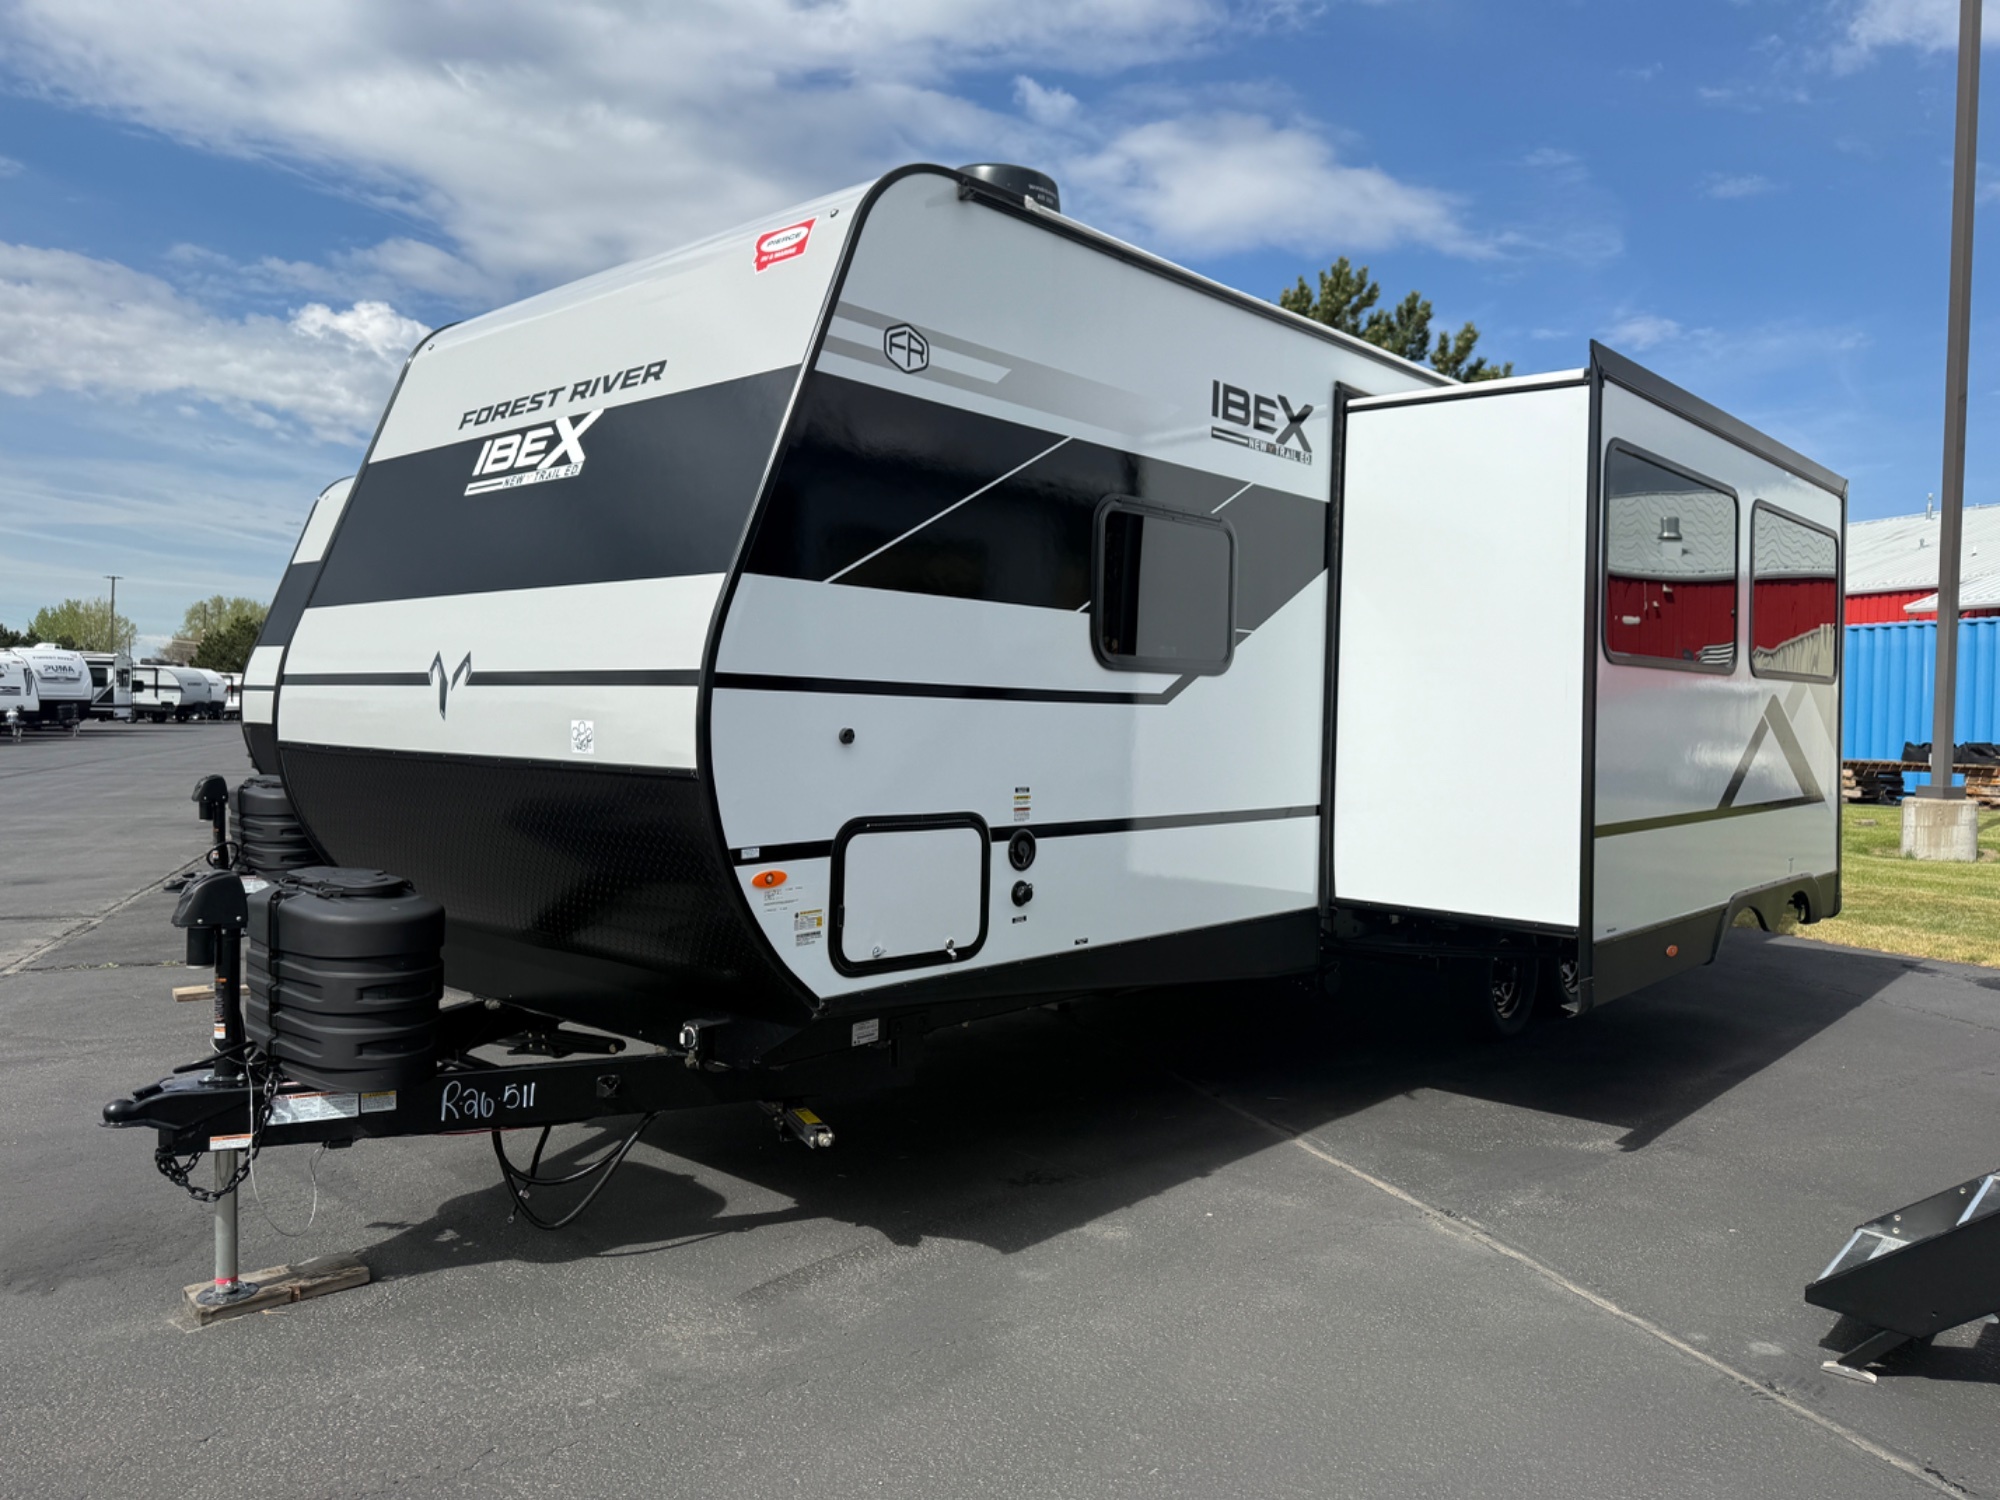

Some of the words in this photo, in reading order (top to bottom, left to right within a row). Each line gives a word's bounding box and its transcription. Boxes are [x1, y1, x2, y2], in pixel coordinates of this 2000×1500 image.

[766, 231, 802, 247] PIERCE
[458, 386, 567, 430] FOREST
[568, 359, 668, 403] RIVER
[1211, 379, 1314, 453] IBEX
[471, 408, 605, 477] IBEX
[1248, 437, 1267, 452] NEW
[1276, 445, 1299, 461] TRAIL
[502, 473, 526, 488] NEW
[534, 467, 561, 482] TRAIL
[43, 664, 75, 673] PUMA
